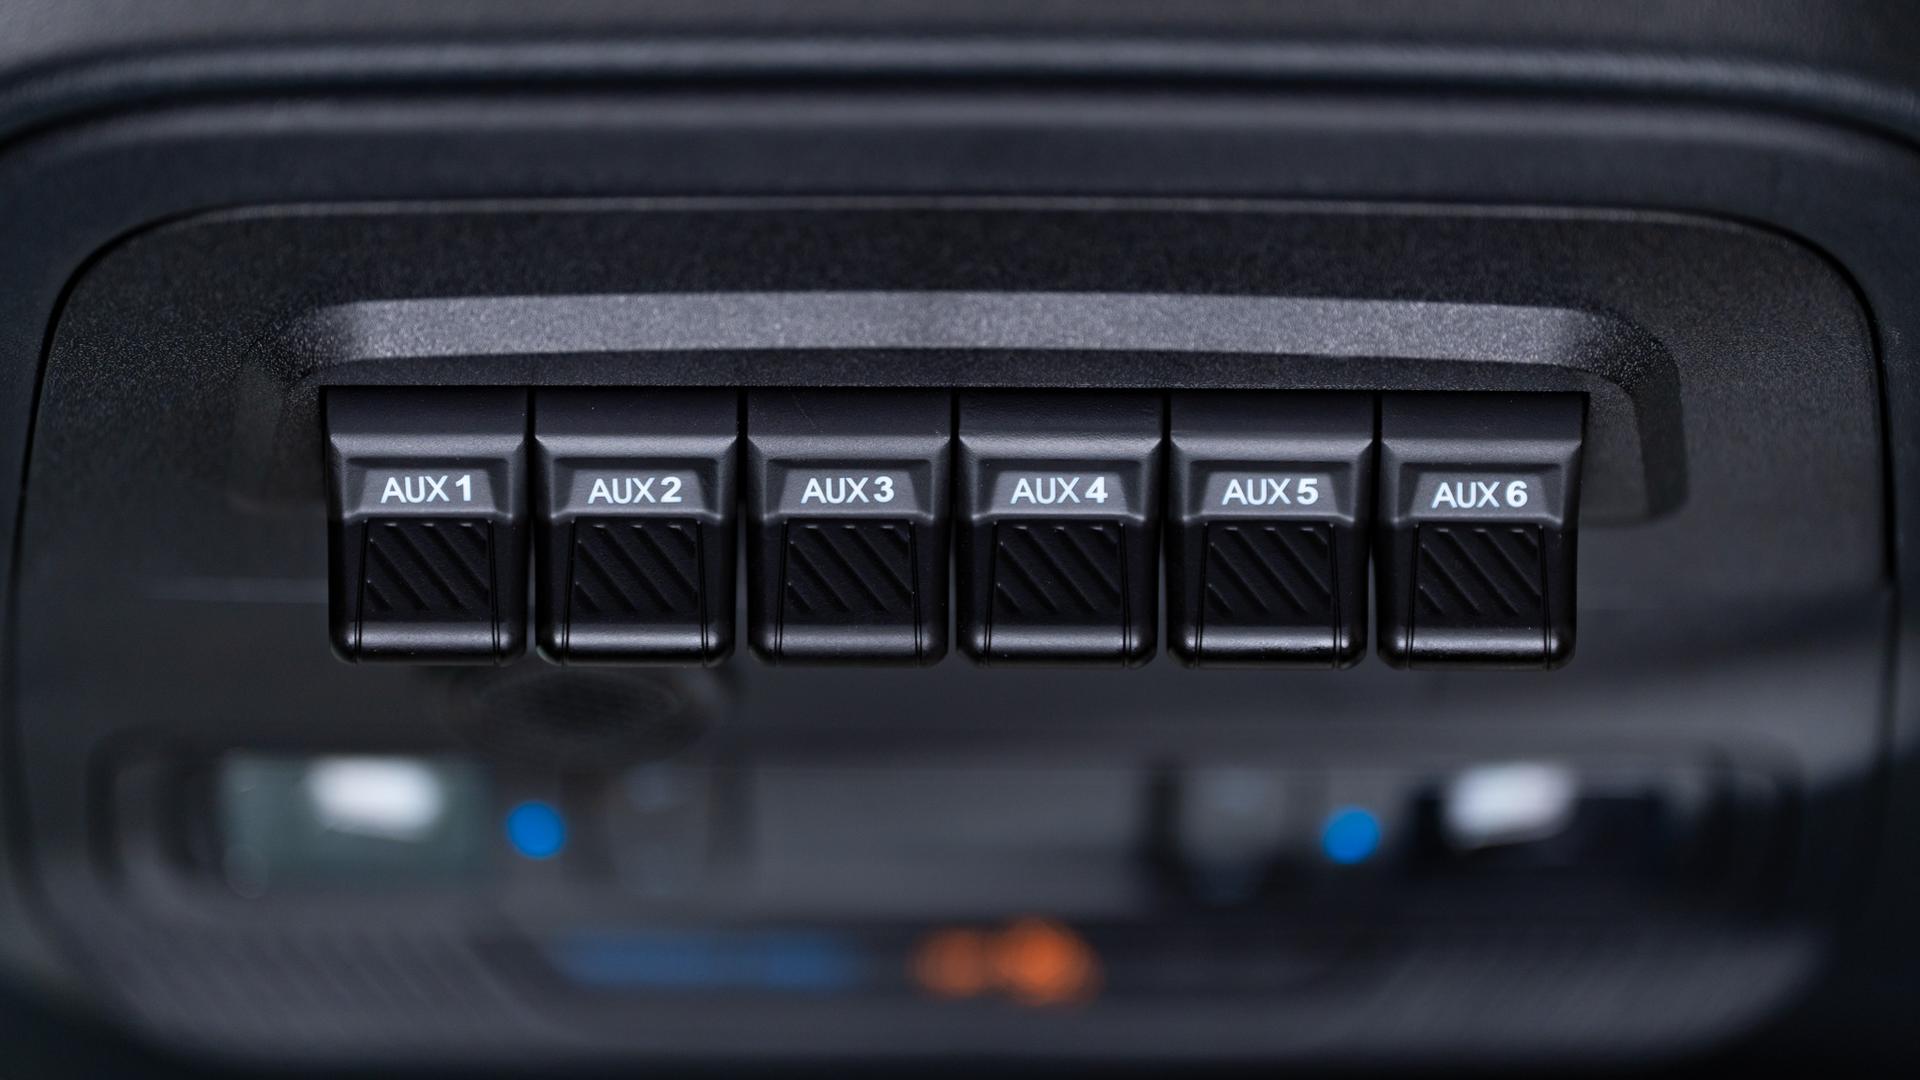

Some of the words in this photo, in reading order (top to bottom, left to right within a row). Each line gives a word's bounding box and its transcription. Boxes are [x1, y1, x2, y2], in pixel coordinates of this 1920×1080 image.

[381, 476, 449, 504] AUX
[455, 474, 472, 502] 1
[587, 478, 656, 504] AUX
[660, 476, 683, 503] 2
[800, 477, 869, 504] AUX
[873, 476, 895, 503] 3
[1009, 477, 1080, 504] AUX
[1085, 477, 1109, 503] 4
[1221, 478, 1291, 505] AUX
[1296, 477, 1319, 506] 5
[1431, 482, 1500, 508] AUX
[1505, 480, 1528, 508] 6
